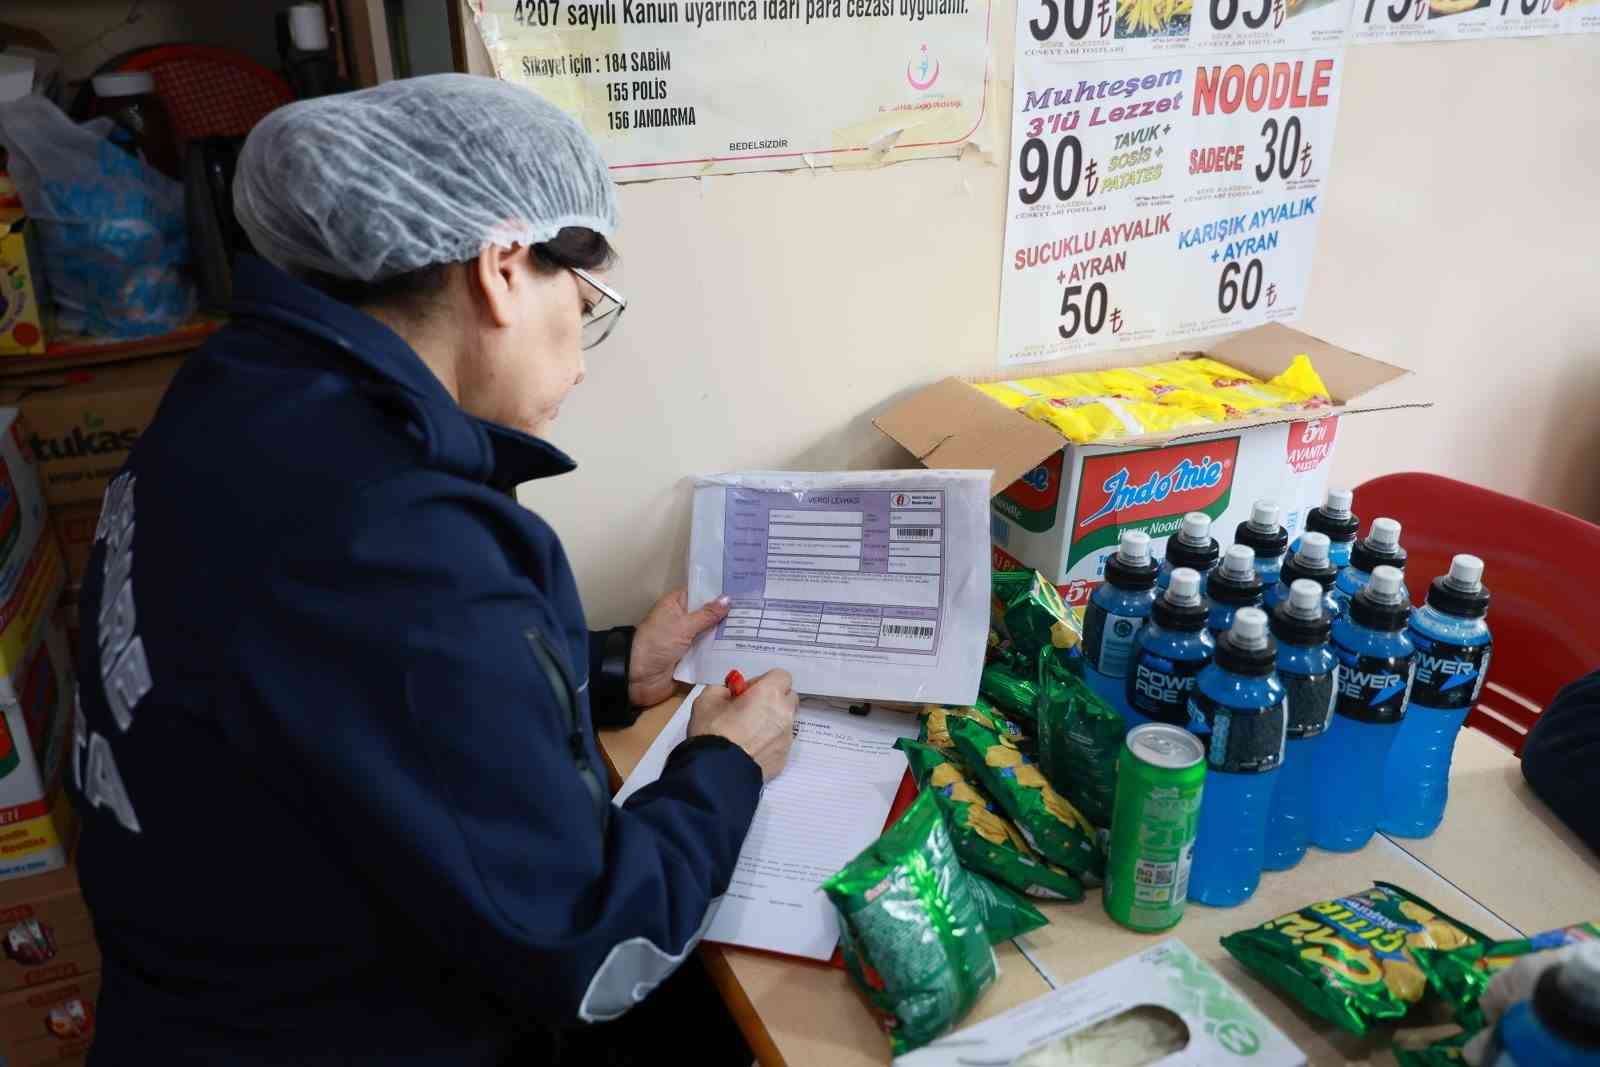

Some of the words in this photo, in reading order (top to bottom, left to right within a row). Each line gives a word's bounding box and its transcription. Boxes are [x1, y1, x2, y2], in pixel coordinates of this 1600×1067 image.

[624, 0, 679, 24] Kanun
[806, 0, 841, 24] para
[569, 53, 592, 77] için
[604, 52, 627, 73] 184
[631, 48, 671, 72] SABİM
[606, 83, 628, 102] 155
[632, 77, 667, 101] POLİS
[1022, 68, 1183, 112] Muhteşem
[1192, 59, 1334, 116] NOODLE
[607, 111, 630, 130] 156
[633, 107, 696, 128] JANDARMA
[1026, 110, 1080, 138] 3'lü
[1088, 91, 1183, 127] Lezzet
[1114, 123, 1161, 150] TAVUK
[1108, 146, 1152, 172] SOSİS
[1189, 144, 1245, 175] SADECE
[1100, 162, 1164, 193] PATATES
[1178, 214, 1247, 250] KARIŞIK
[1248, 196, 1318, 231] AYVALIK
[1014, 230, 1096, 270] SUCUKLU
[1099, 212, 1173, 248] AYVALIK
[1222, 230, 1279, 262] AYRAN
[1068, 251, 1127, 284] AYRAN
[1150, 518, 1185, 534] Noodl
[1136, 664, 1196, 691] POWE
[1337, 665, 1401, 689] OWER
